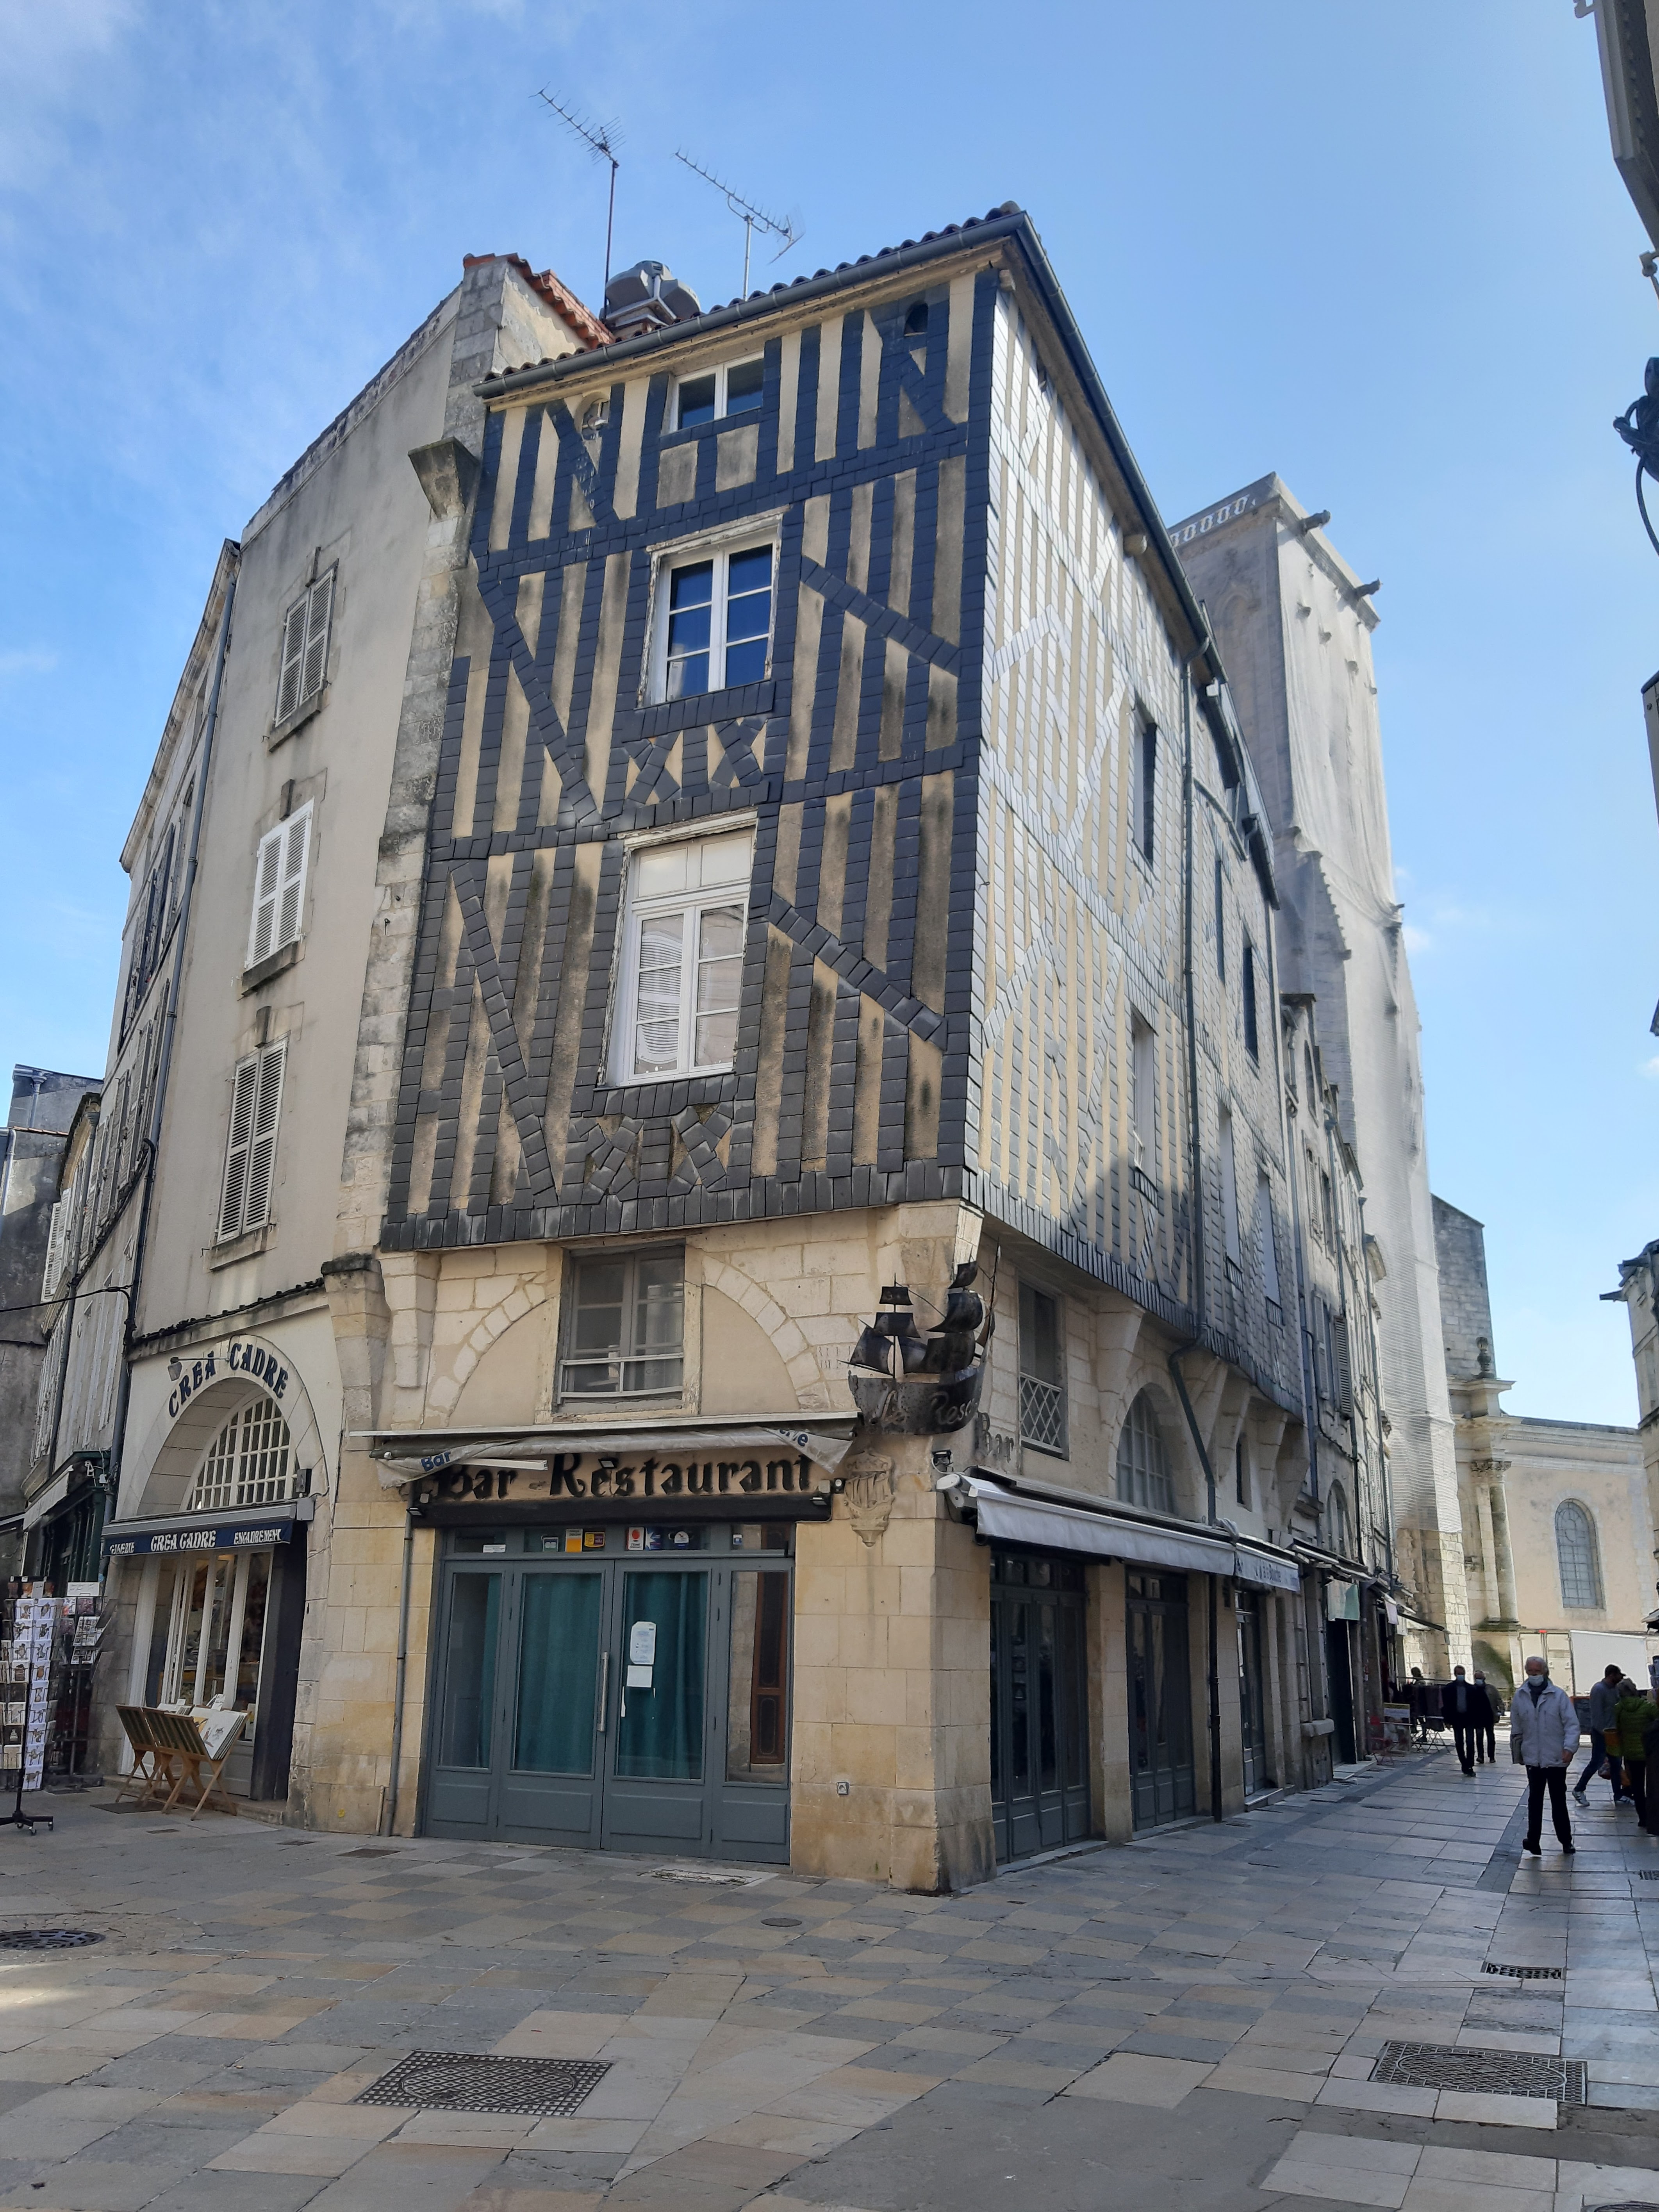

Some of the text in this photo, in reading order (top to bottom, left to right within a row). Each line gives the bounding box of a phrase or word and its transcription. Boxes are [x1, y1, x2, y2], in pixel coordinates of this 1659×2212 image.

[169, 1343, 289, 1418] CREA CADRE
[421, 1452, 451, 1472] Bar
[430, 1464, 519, 1500] Bar
[150, 1535, 178, 1552] CREA
[179, 1530, 216, 1549] CADRE
